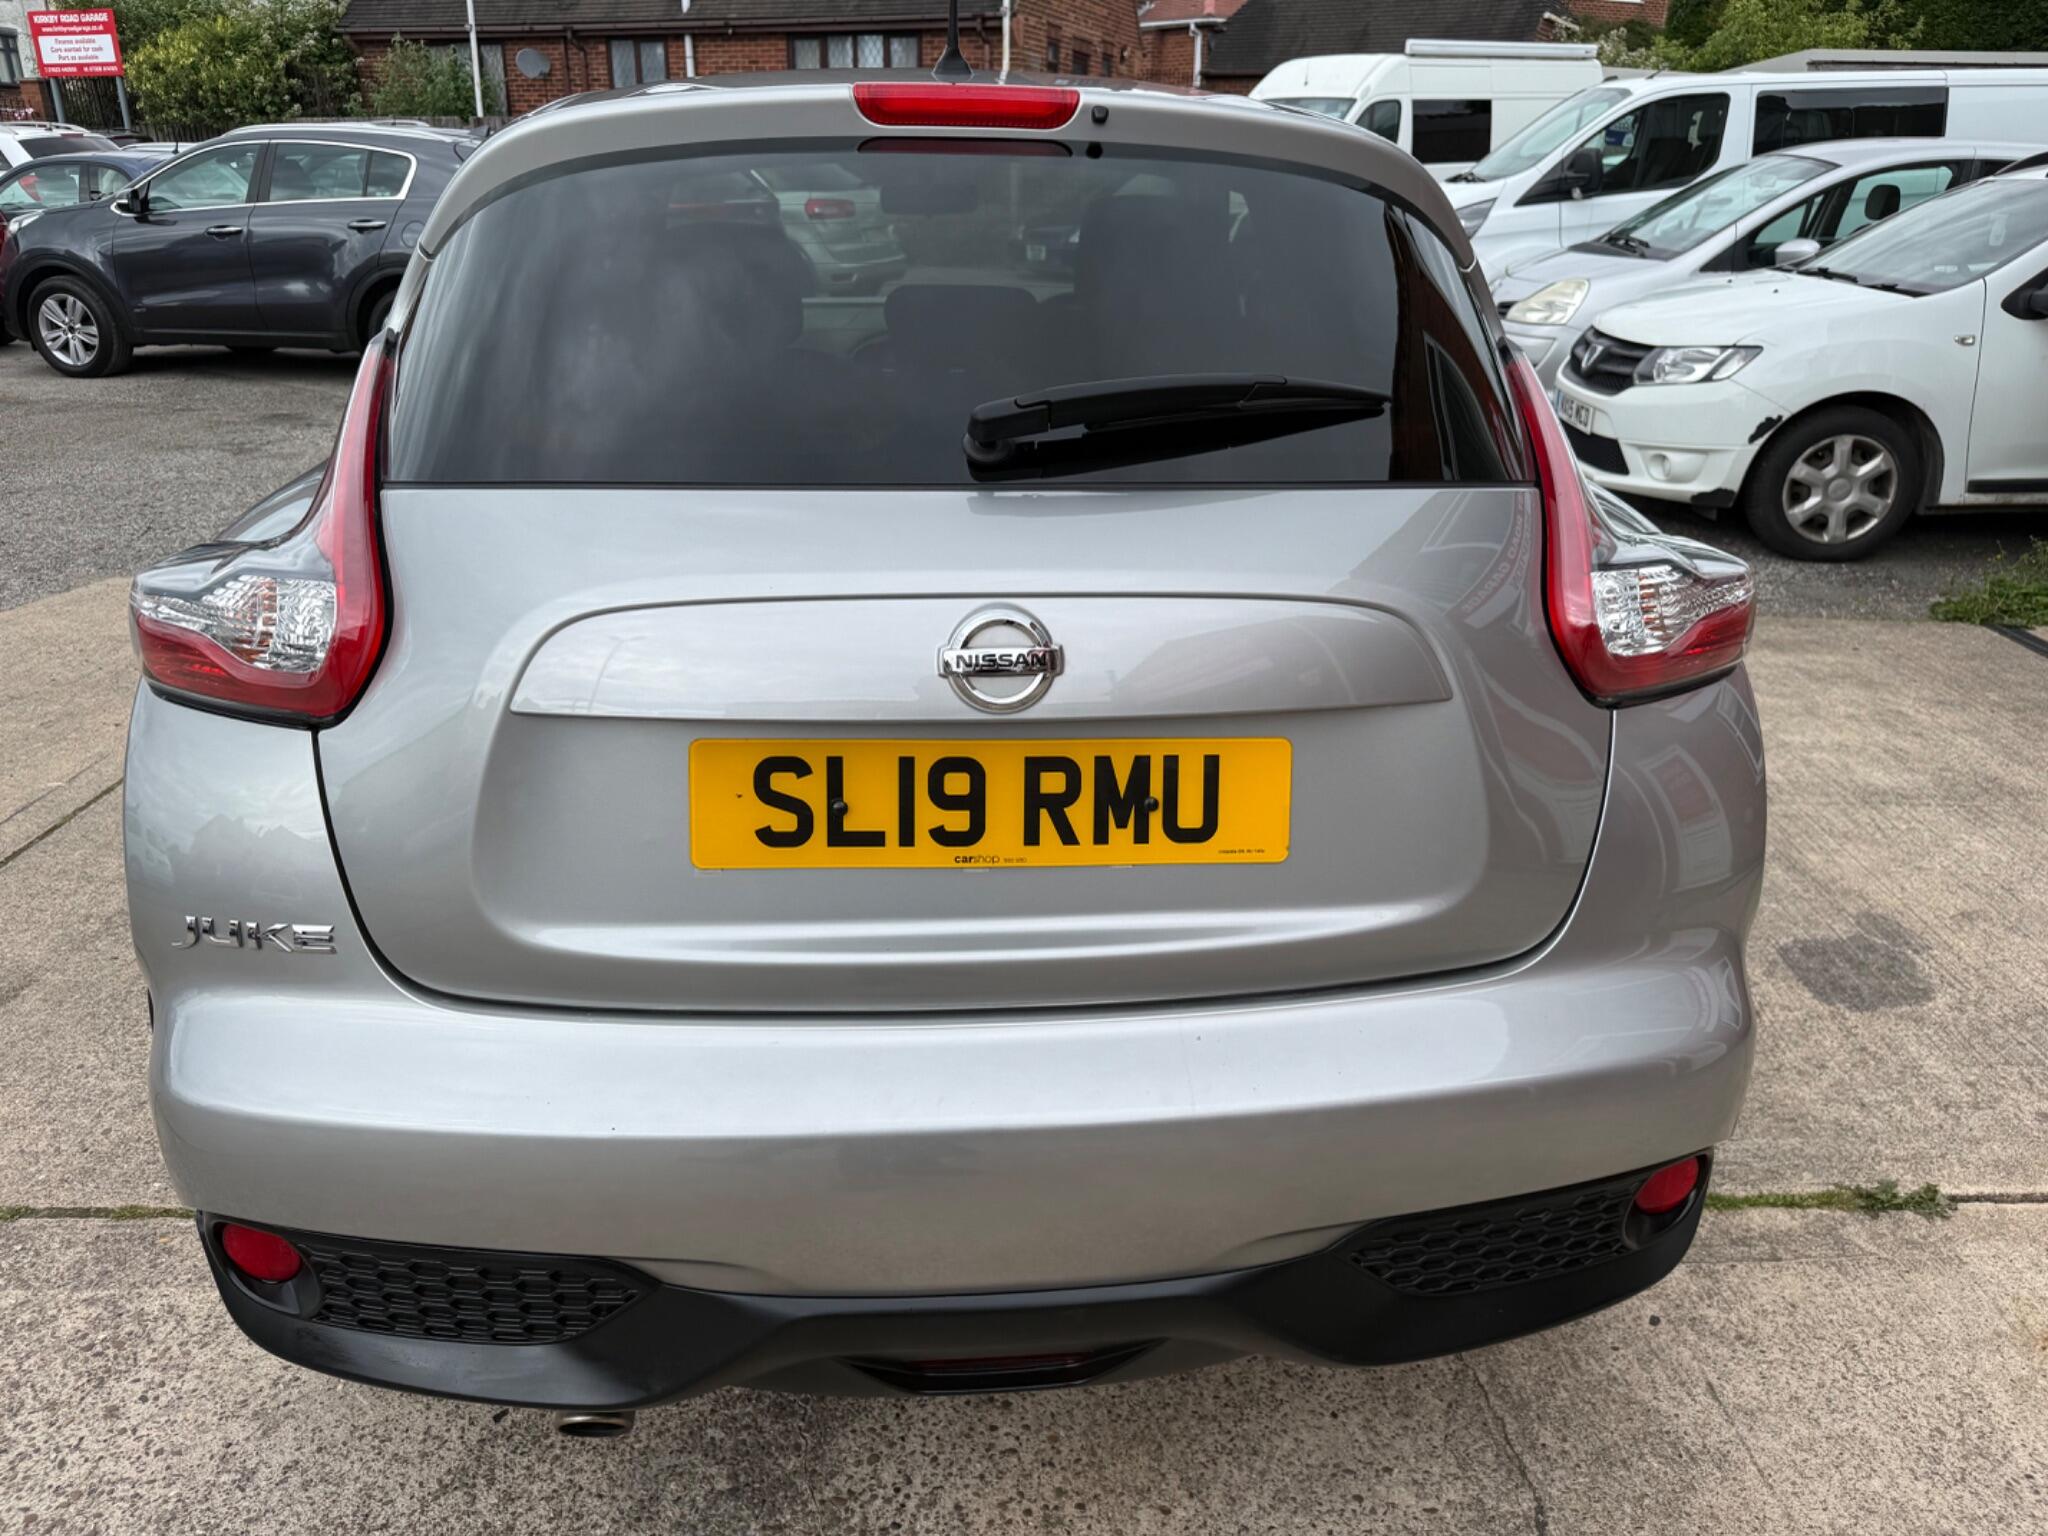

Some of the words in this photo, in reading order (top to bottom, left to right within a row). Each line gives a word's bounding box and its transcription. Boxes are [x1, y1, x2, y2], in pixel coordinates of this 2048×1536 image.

[33, 14, 58, 23] KIRKBY
[60, 13, 80, 22] ROAD
[81, 12, 109, 22] GARAGE
[956, 652, 1047, 670] NISSAN
[753, 755, 987, 848] SL19
[1023, 753, 1220, 846] RMU
[171, 914, 338, 954] JUKE
